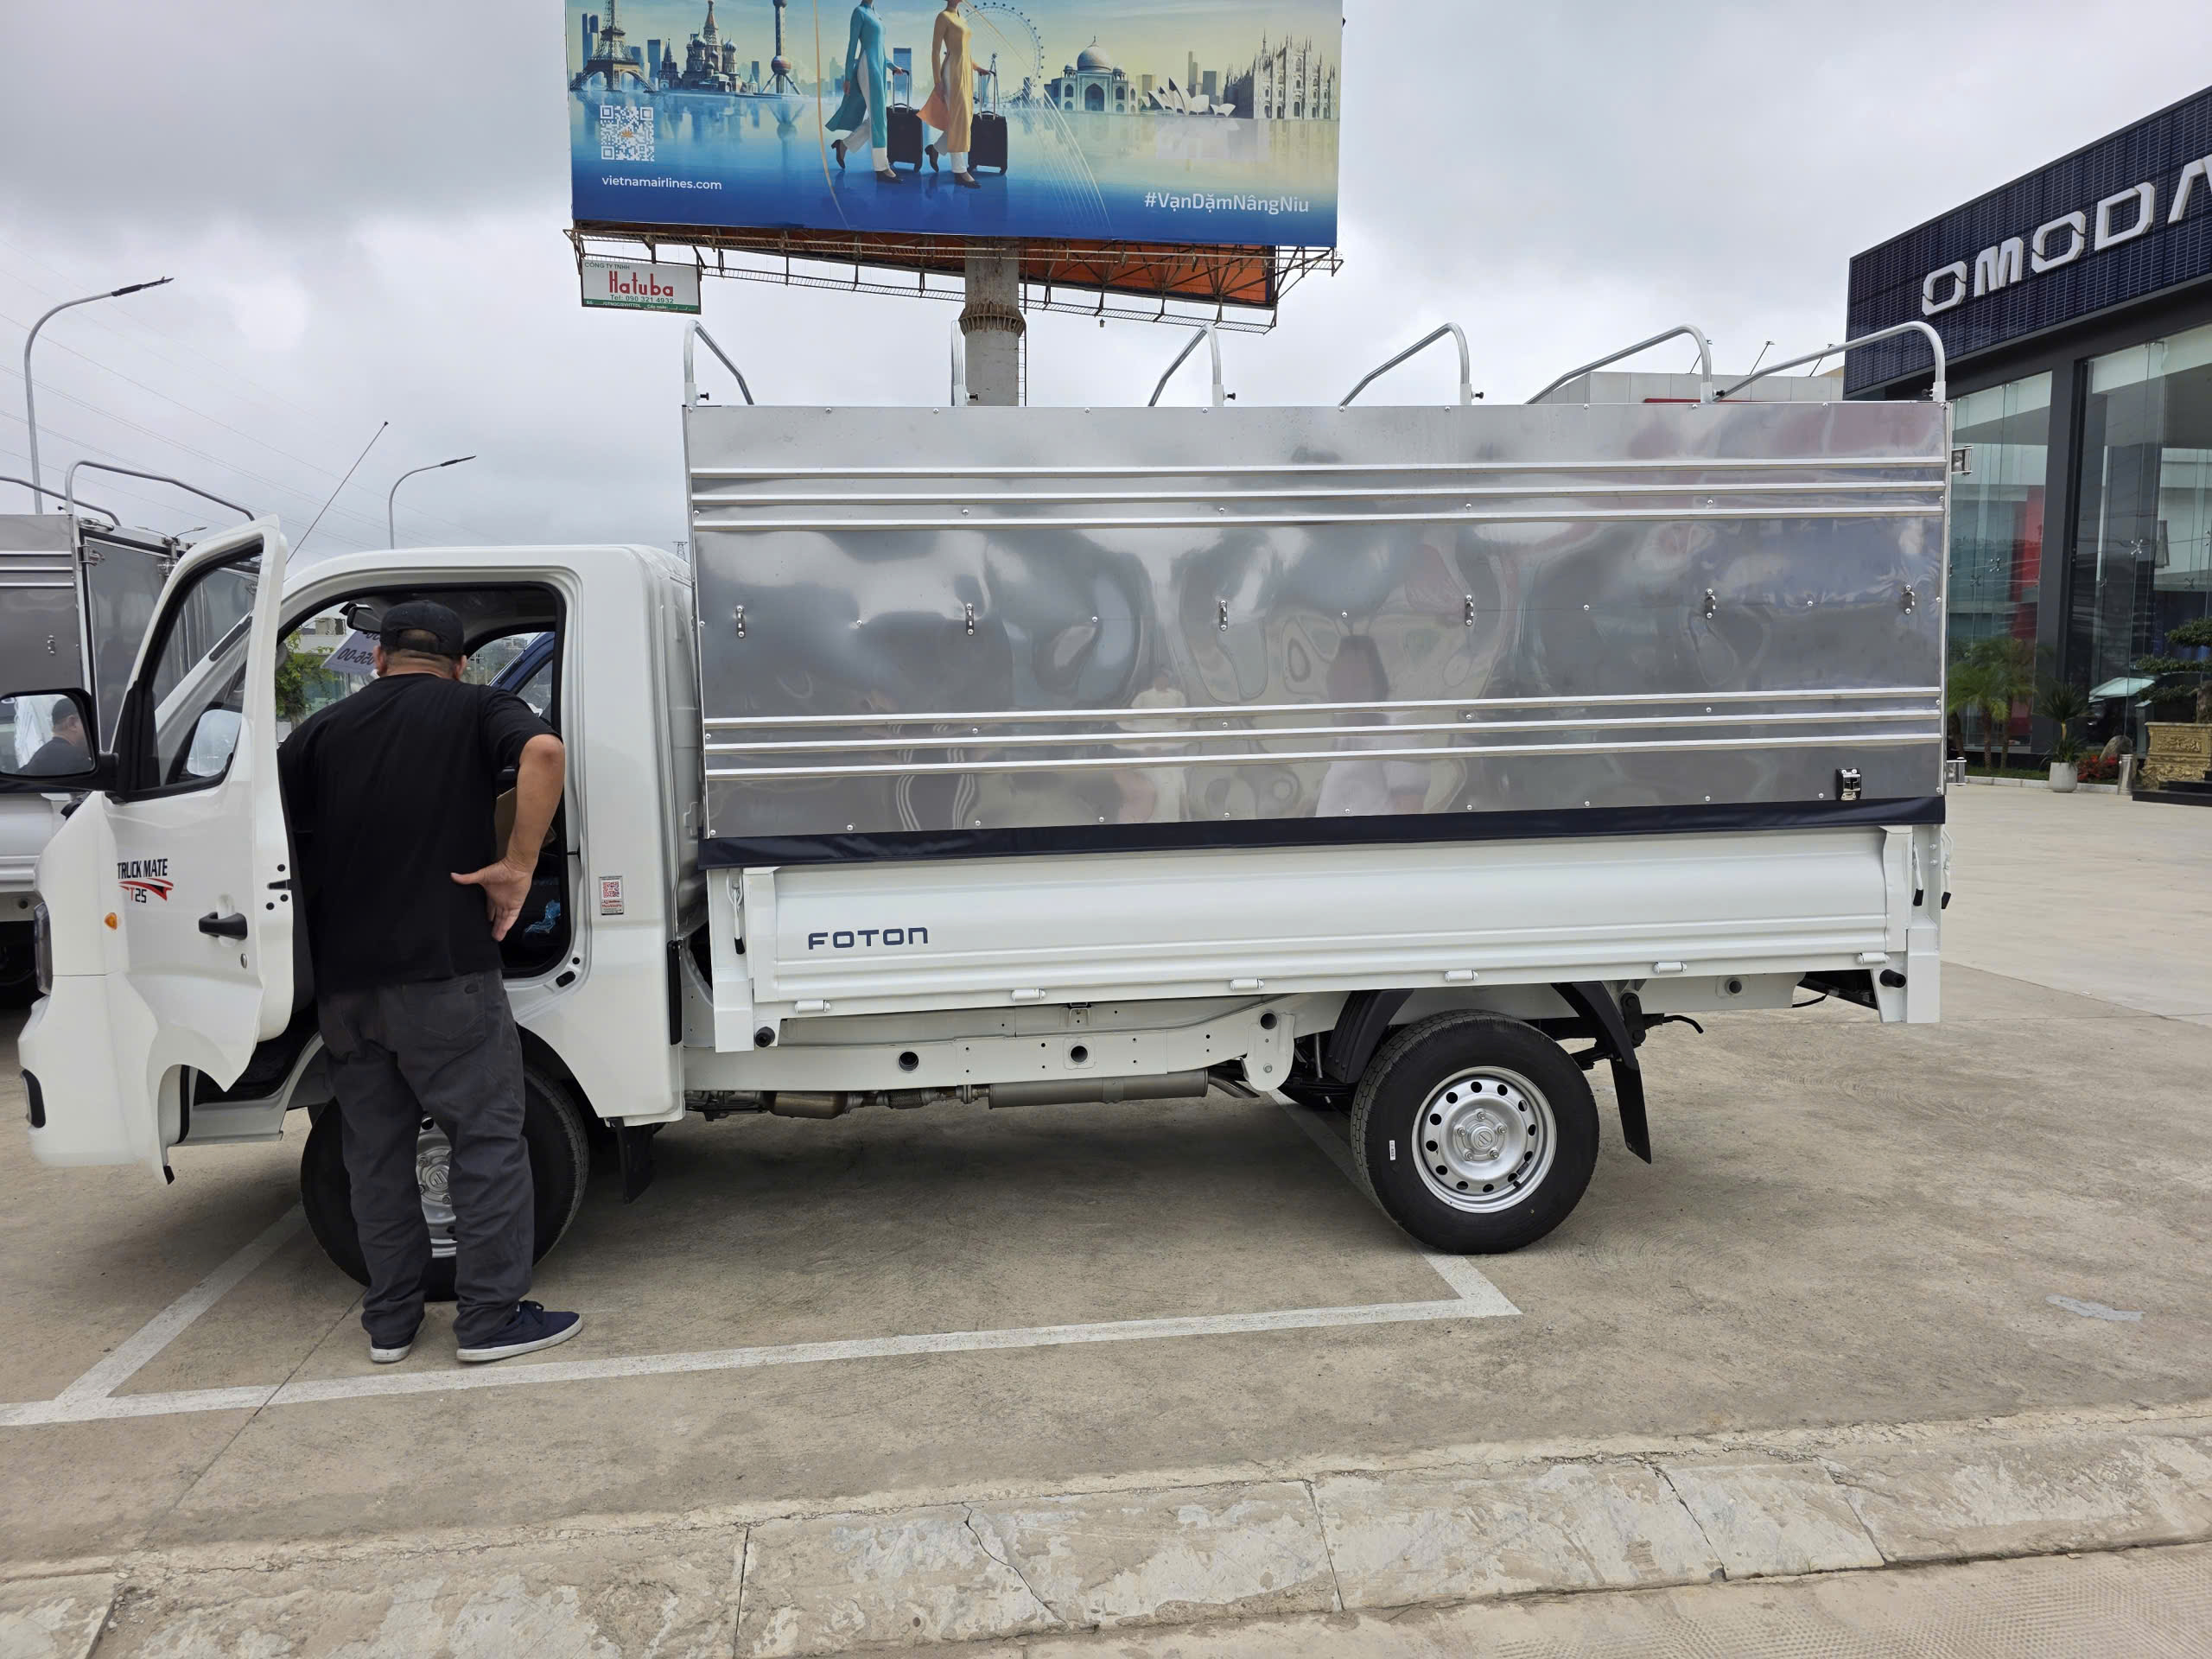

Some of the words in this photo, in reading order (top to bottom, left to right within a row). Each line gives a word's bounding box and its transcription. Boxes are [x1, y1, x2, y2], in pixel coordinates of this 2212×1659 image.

[601, 175, 722, 190] vietnamairlines.com
[1144, 192, 1309, 215] #VạnDặmNângNiu
[609, 270, 674, 296] Hatuba
[117, 860, 142, 880] TRUCK
[143, 858, 168, 878] MATE
[130, 887, 148, 904] T25
